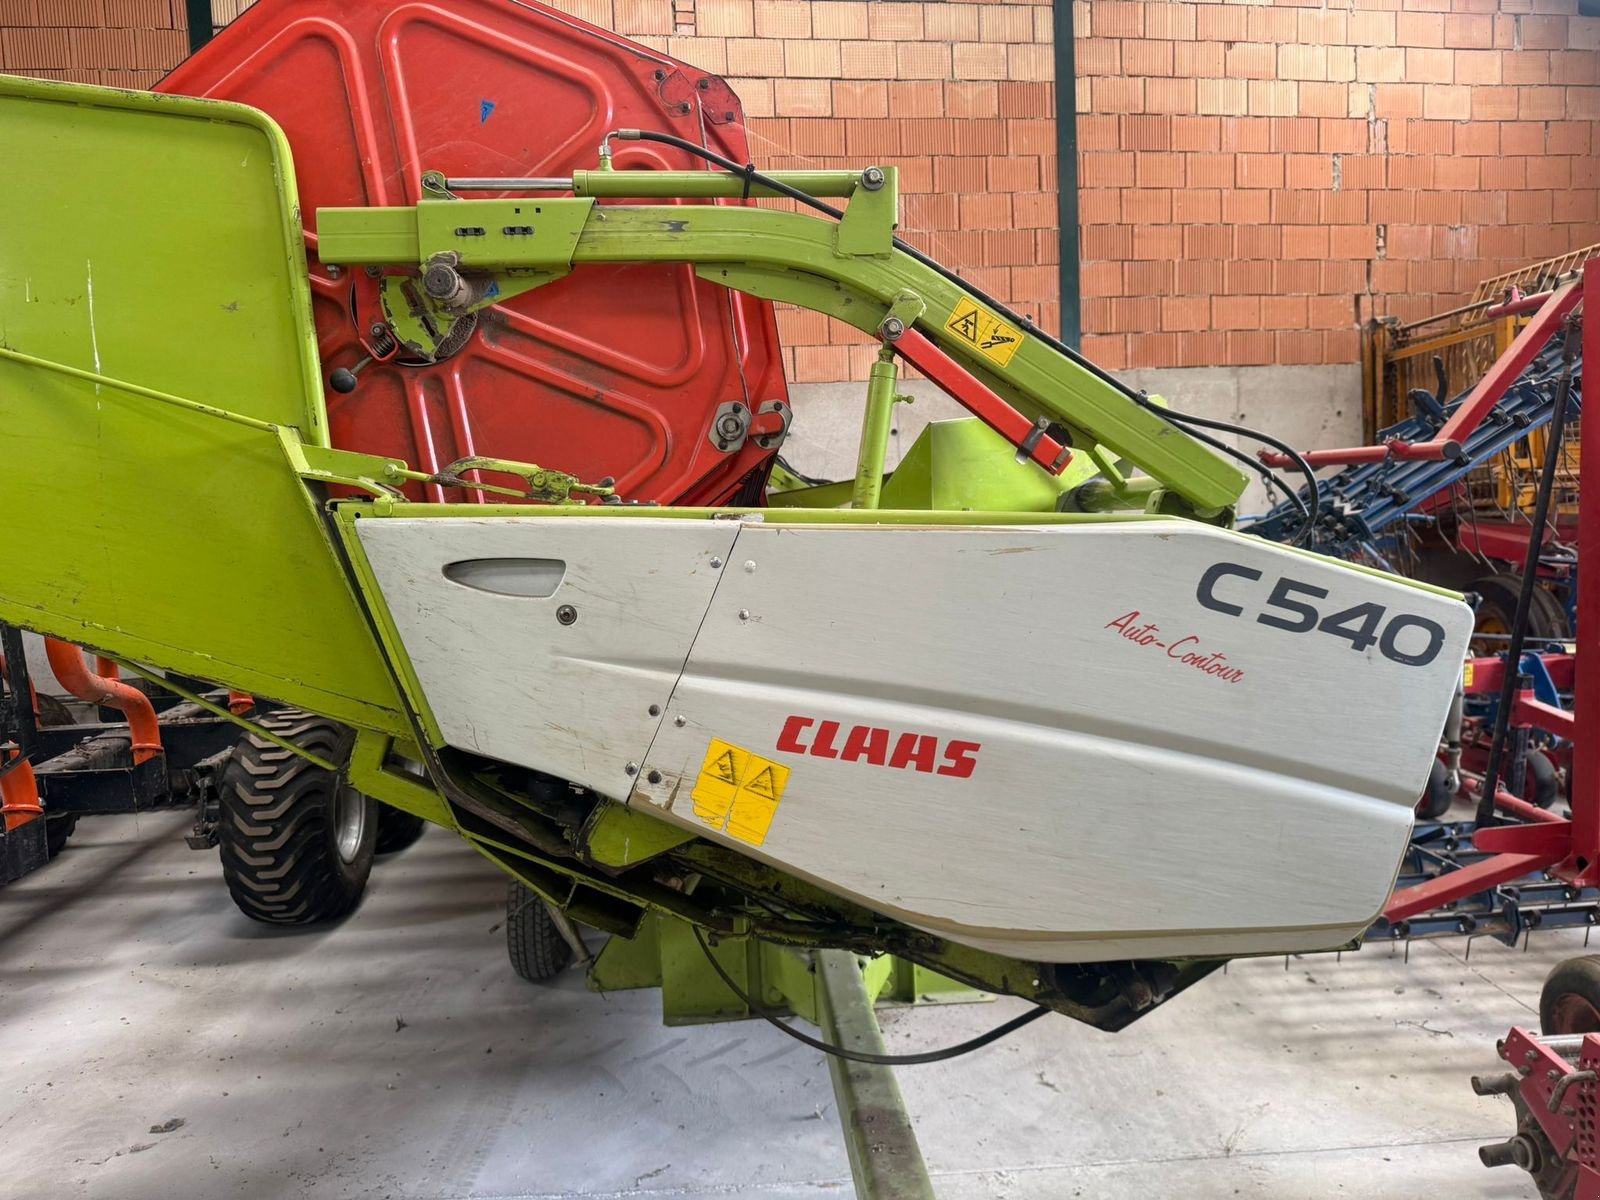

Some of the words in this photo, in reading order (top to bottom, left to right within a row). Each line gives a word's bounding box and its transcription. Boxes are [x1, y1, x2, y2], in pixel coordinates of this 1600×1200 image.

[1105, 611, 1244, 684] Auto-Contour
[1196, 562, 1263, 617] C
[1256, 577, 1446, 667] 540
[776, 715, 981, 779] CLAAS
